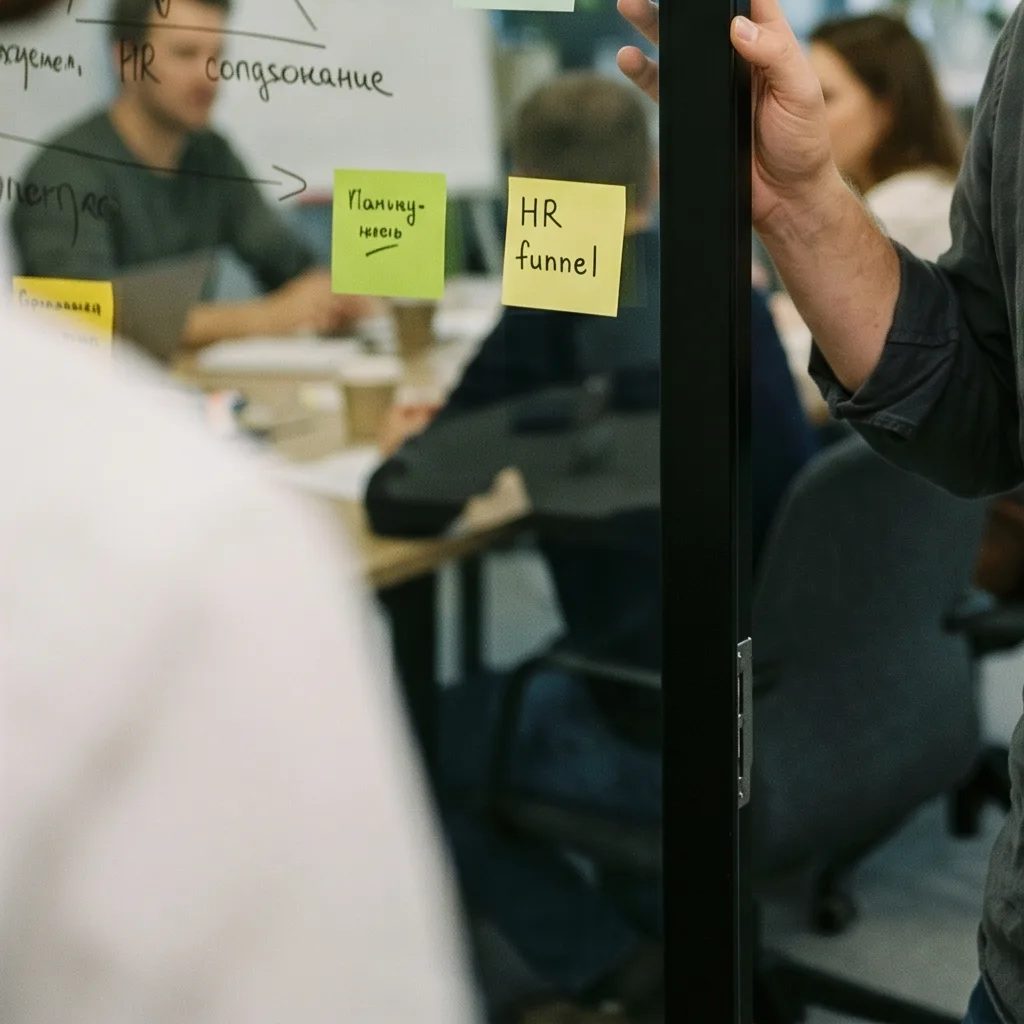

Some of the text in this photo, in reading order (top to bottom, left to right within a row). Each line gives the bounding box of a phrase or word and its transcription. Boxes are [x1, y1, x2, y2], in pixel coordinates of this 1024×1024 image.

[120, 39, 161, 84] HR
[521, 196, 562, 228] HR
[515, 239, 597, 277] funnel
